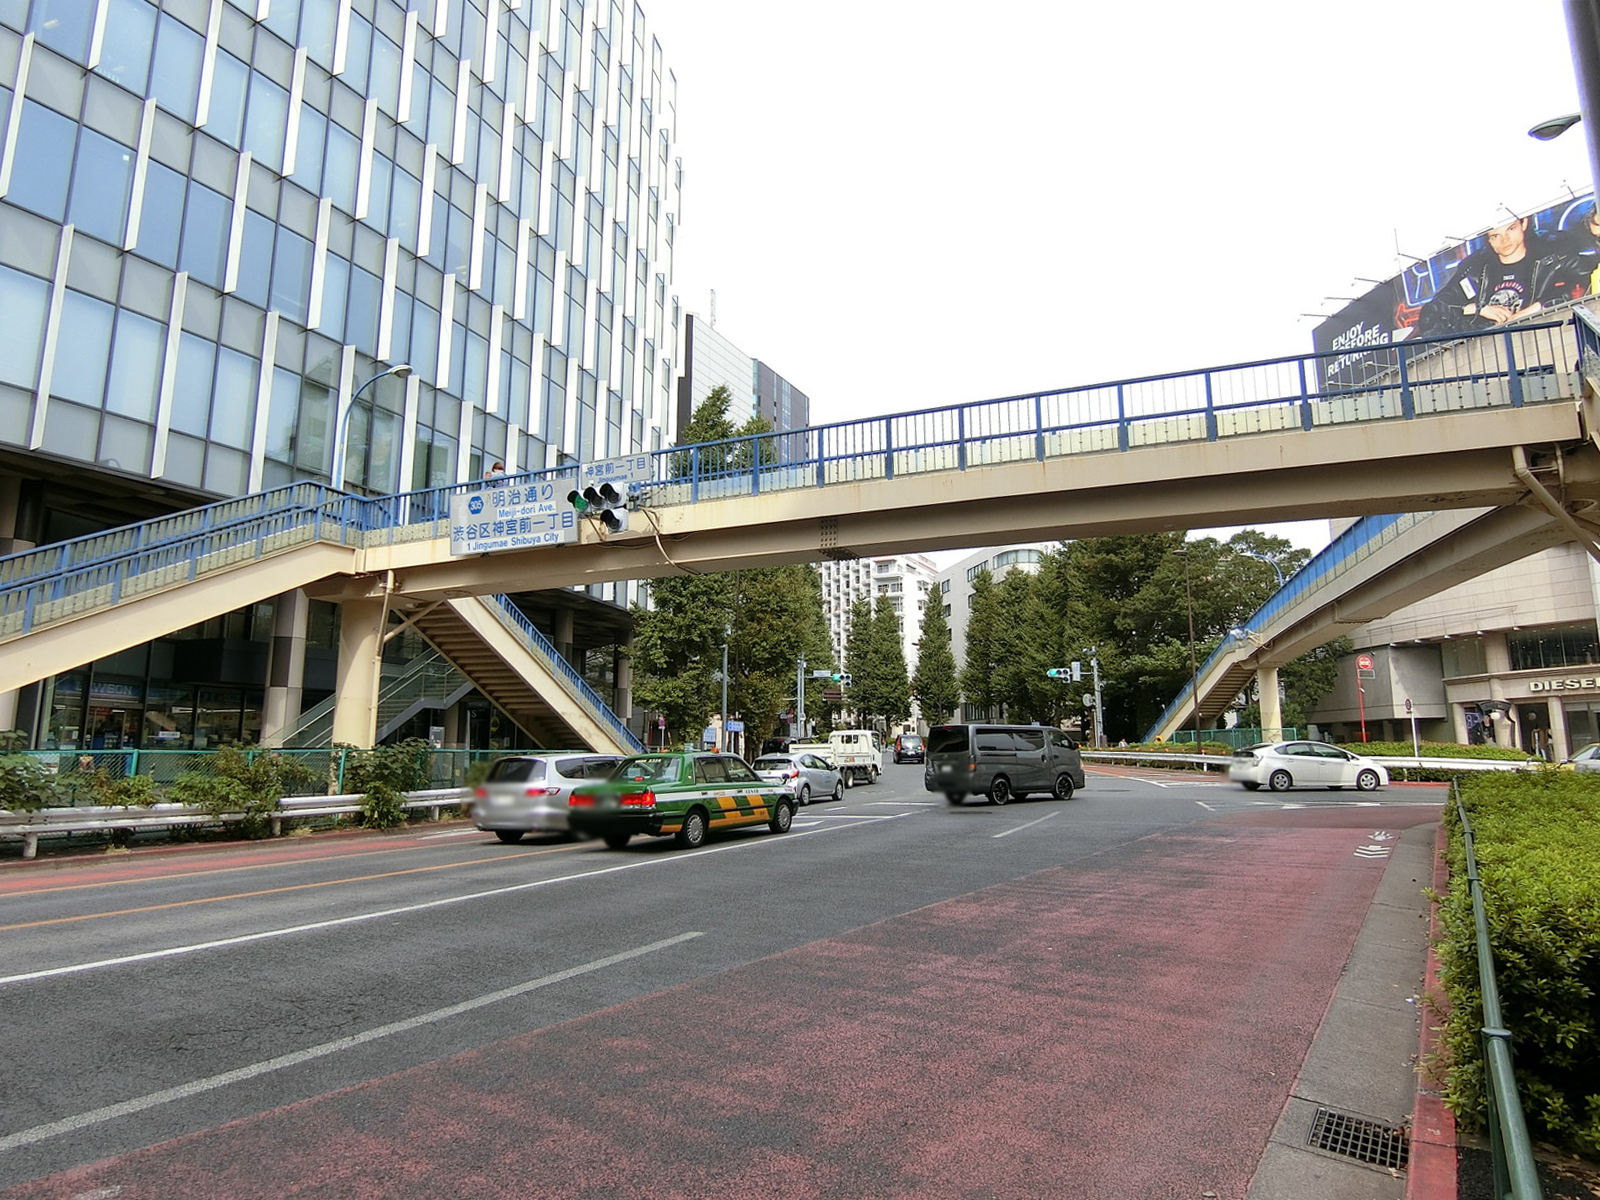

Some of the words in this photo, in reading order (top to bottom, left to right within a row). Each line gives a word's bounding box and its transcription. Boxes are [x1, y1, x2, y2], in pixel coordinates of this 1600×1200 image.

[1332, 321, 1364, 351] ENJOY
[585, 457, 645, 477] 神宮前一丁目
[470, 500, 482, 511] 305
[492, 484, 554, 508] 明治通り
[498, 505, 536, 518] Meiji-dori
[538, 503, 555, 513] Ave.
[453, 511, 573, 542] 渋谷区神宮前一丁目
[467, 543, 471, 551] 1
[472, 539, 508, 551] Jingumae
[511, 535, 541, 547] Shibuya
[543, 532, 559, 543] City
[75, 682, 133, 695] LWSON
